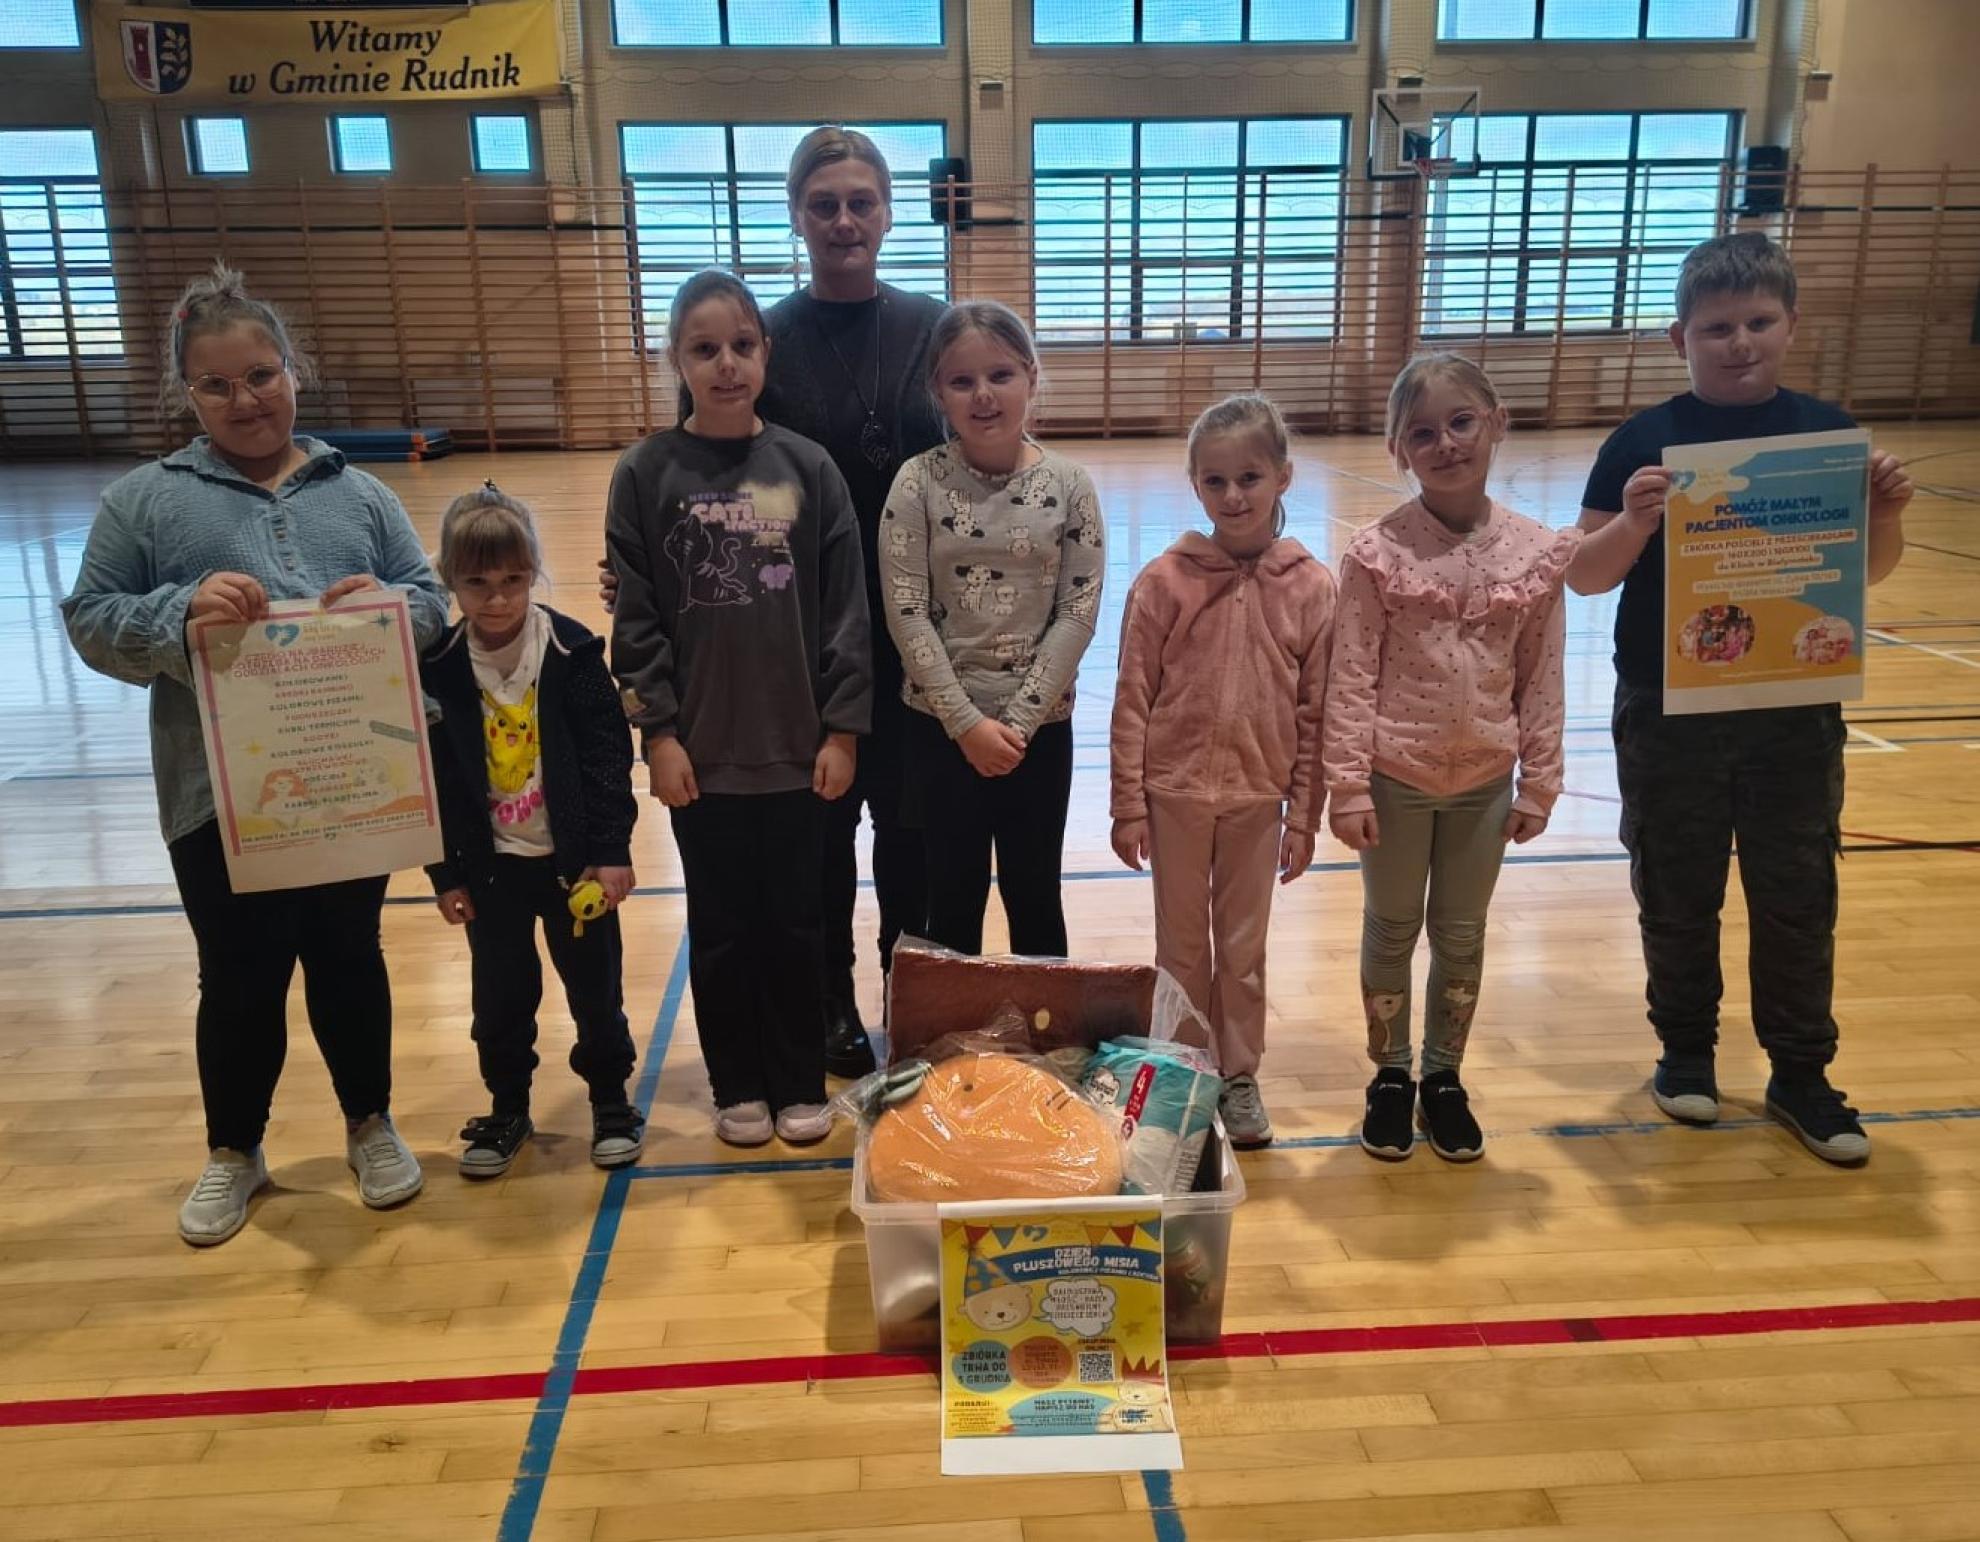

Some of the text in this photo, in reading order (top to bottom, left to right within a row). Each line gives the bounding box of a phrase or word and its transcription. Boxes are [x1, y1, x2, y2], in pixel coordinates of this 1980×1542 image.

[308, 20, 443, 56] Witamy
[228, 52, 520, 94] w Gminie Rudnik
[1714, 496, 1822, 516] POMÓŻ MAŁYM
[1685, 507, 1850, 533] PACJENTOM ONKOLOGII
[1012, 1256, 1140, 1273] PLUSZOWEGO MISIA
[961, 1349, 1006, 1361] ZBIÓRKA
[991, 1361, 1007, 1372] DO
[966, 1374, 1011, 1385] GRUDNIA
